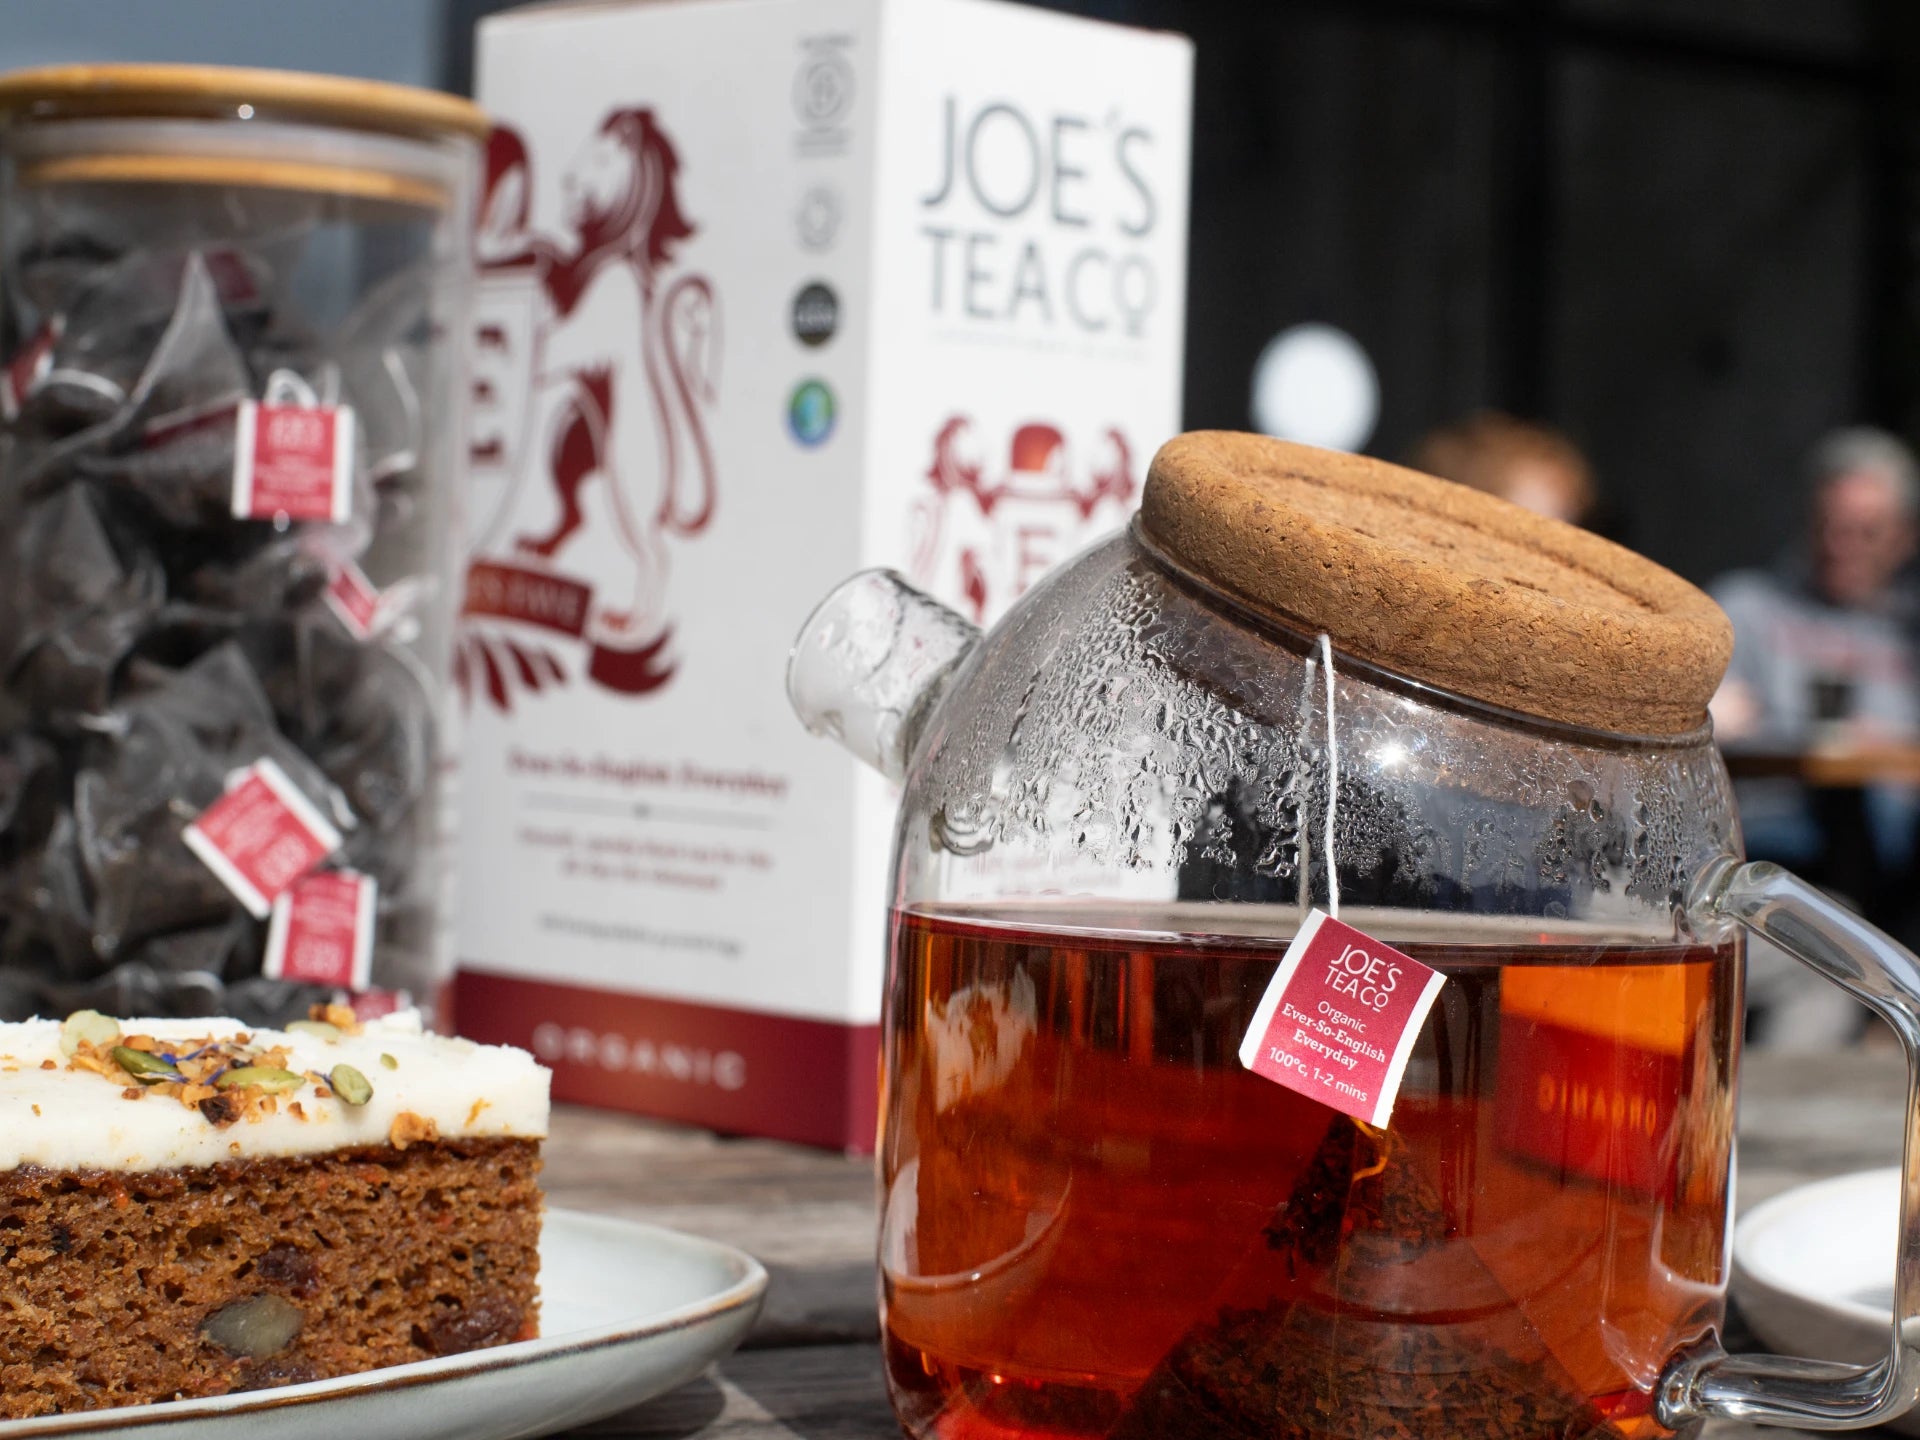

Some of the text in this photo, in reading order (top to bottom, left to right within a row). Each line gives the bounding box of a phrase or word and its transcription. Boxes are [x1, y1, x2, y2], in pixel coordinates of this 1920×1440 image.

[921, 92, 1157, 238] JOE'S
[1330, 943, 1403, 993] JOE'S
[1281, 1002, 1387, 1063] Ever-So-English
[1317, 1000, 1368, 1034] Organic
[1292, 1028, 1359, 1071] Everyday
[1312, 1067, 1335, 1087] 1-2
[1335, 1079, 1369, 1102] mins
